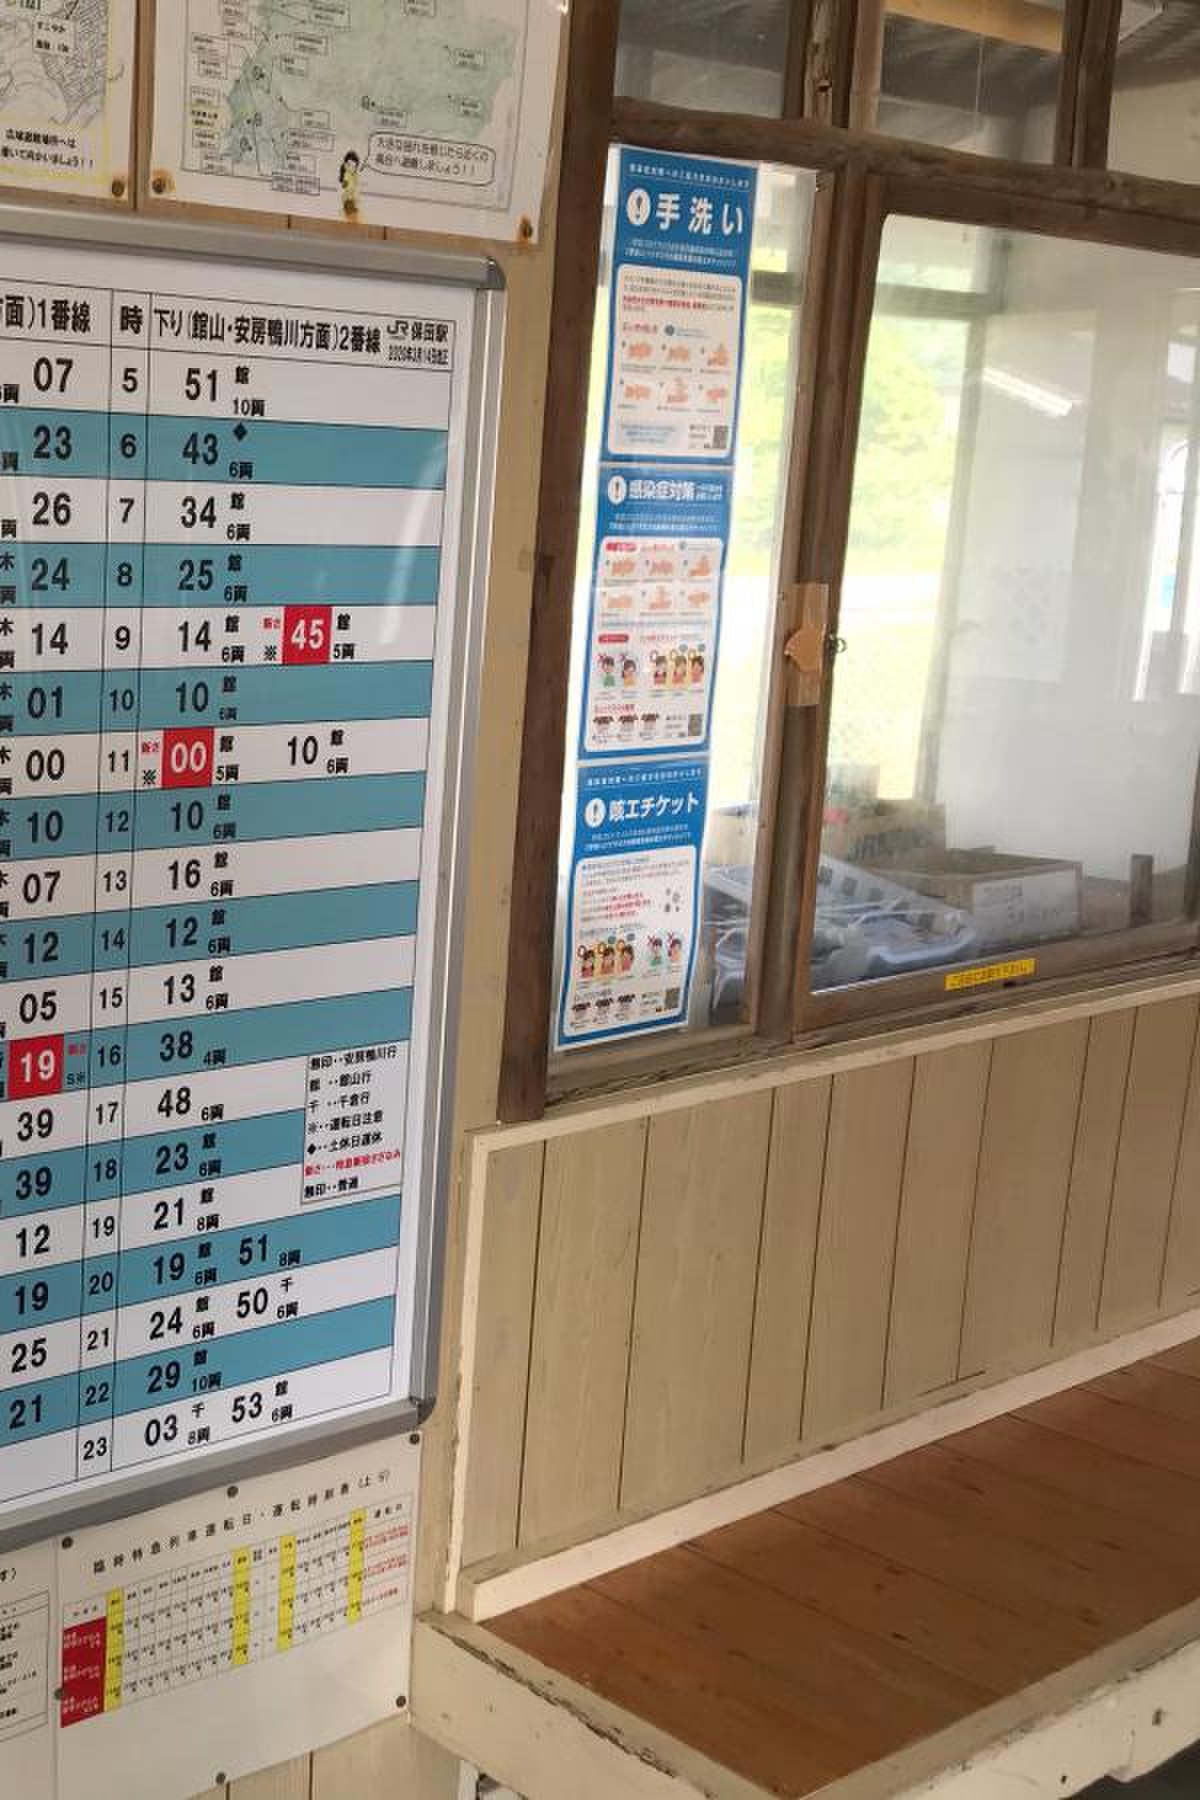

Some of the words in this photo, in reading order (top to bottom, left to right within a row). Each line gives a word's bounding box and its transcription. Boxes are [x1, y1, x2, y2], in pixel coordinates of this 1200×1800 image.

[656, 193, 743, 235] 手洗い
[120, 306, 142, 334] 時
[387, 321, 408, 336] JR
[411, 321, 448, 342] 保田駅
[34, 357, 72, 392] 07
[123, 368, 137, 392] 5
[186, 368, 216, 401] 51
[234, 399, 264, 416] 10両
[34, 425, 71, 460] 23
[121, 434, 136, 458] 6
[183, 433, 218, 465] 43
[229, 462, 253, 479] 6両
[33, 492, 70, 525] 26
[120, 498, 134, 523] 7
[181, 496, 216, 528] 34
[227, 524, 250, 540] 6両
[0, 552, 14, 570] 木
[32, 558, 69, 590] 24
[118, 563, 132, 586] 8
[179, 560, 212, 590] 25
[224, 586, 247, 602] 6両
[32, 624, 68, 654] 14
[116, 626, 130, 650] 9
[179, 621, 211, 651] 14
[222, 646, 244, 662] 6両
[291, 619, 324, 650] 45
[334, 644, 354, 659] 5両
[28, 686, 62, 718] 01
[110, 689, 134, 711] 10
[176, 682, 208, 712] 10
[26, 749, 64, 781] 00
[109, 750, 128, 772] 11
[171, 742, 207, 773] 00
[216, 765, 238, 781] 5両
[288, 736, 318, 765] 10
[327, 758, 348, 774] 6両
[28, 811, 62, 842] 10
[106, 811, 128, 832] 12
[171, 801, 203, 832] 10
[23, 871, 60, 903] 07
[104, 870, 126, 892] 13
[169, 860, 200, 890] 16
[211, 880, 233, 896] 6両
[25, 932, 58, 964] 12
[102, 928, 124, 951] 14
[167, 917, 197, 948] 12
[208, 937, 230, 953] 6両
[20, 991, 56, 1024] 05
[100, 987, 122, 1008] 15
[164, 974, 194, 1004] 13
[206, 994, 228, 1010] 6両
[98, 1045, 120, 1067] 16
[160, 1031, 192, 1061] 38
[20, 1051, 54, 1083] 19
[96, 1102, 118, 1124] 17
[158, 1087, 190, 1117] 48
[18, 1109, 53, 1141] 39
[94, 1159, 116, 1181] 18
[156, 1143, 188, 1174] 23
[16, 1167, 52, 1200] 39
[93, 1216, 114, 1238] 19
[154, 1198, 183, 1230] 21
[16, 1224, 49, 1257] 12
[154, 1253, 184, 1284] 19
[240, 1235, 266, 1265] 51
[16, 1282, 48, 1314] 19
[89, 1272, 113, 1295] 20
[150, 1307, 182, 1340] 24
[237, 1288, 268, 1318] 50
[281, 1277, 292, 1292] 千
[88, 1328, 108, 1350] 21
[12, 1338, 46, 1373] 25
[148, 1361, 180, 1393] 29
[86, 1382, 109, 1406] 22
[10, 1395, 41, 1429] 21
[146, 1415, 177, 1446] 03
[192, 1402, 204, 1418] 千
[232, 1392, 262, 1423] 53
[84, 1437, 106, 1460] 23
